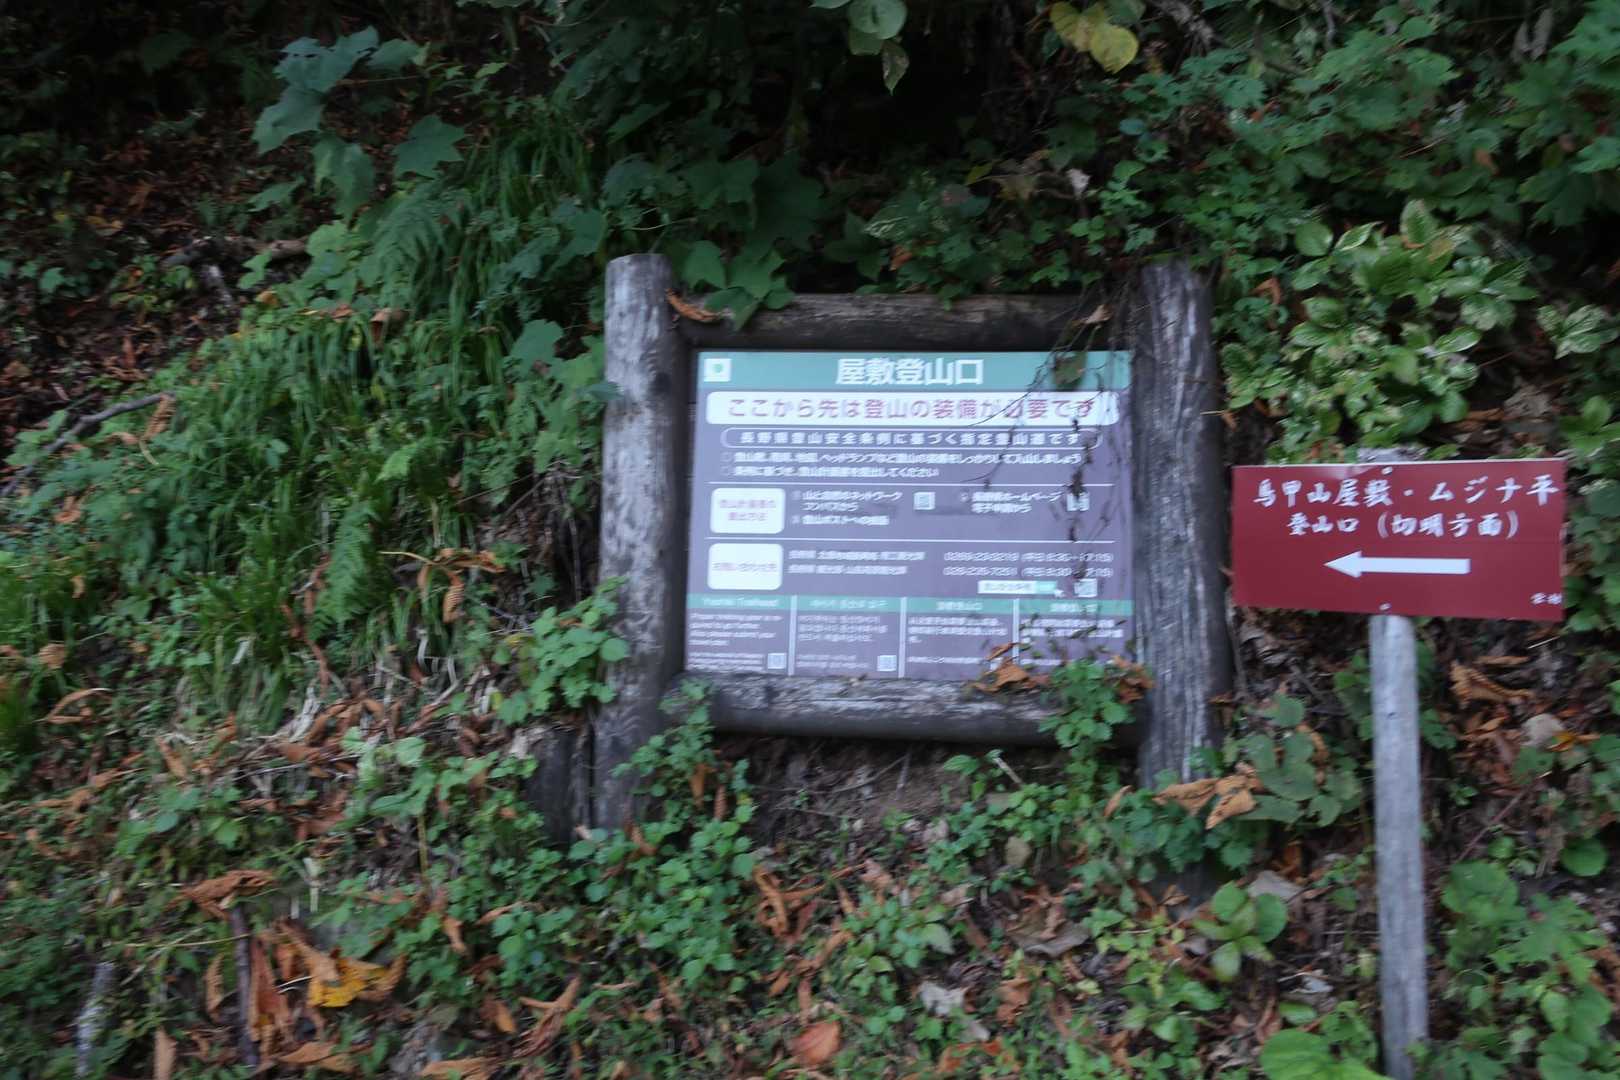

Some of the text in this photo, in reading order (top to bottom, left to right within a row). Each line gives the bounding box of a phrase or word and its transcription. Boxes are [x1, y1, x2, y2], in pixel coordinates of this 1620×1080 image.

[835, 357, 984, 385] 屋敷登山口
